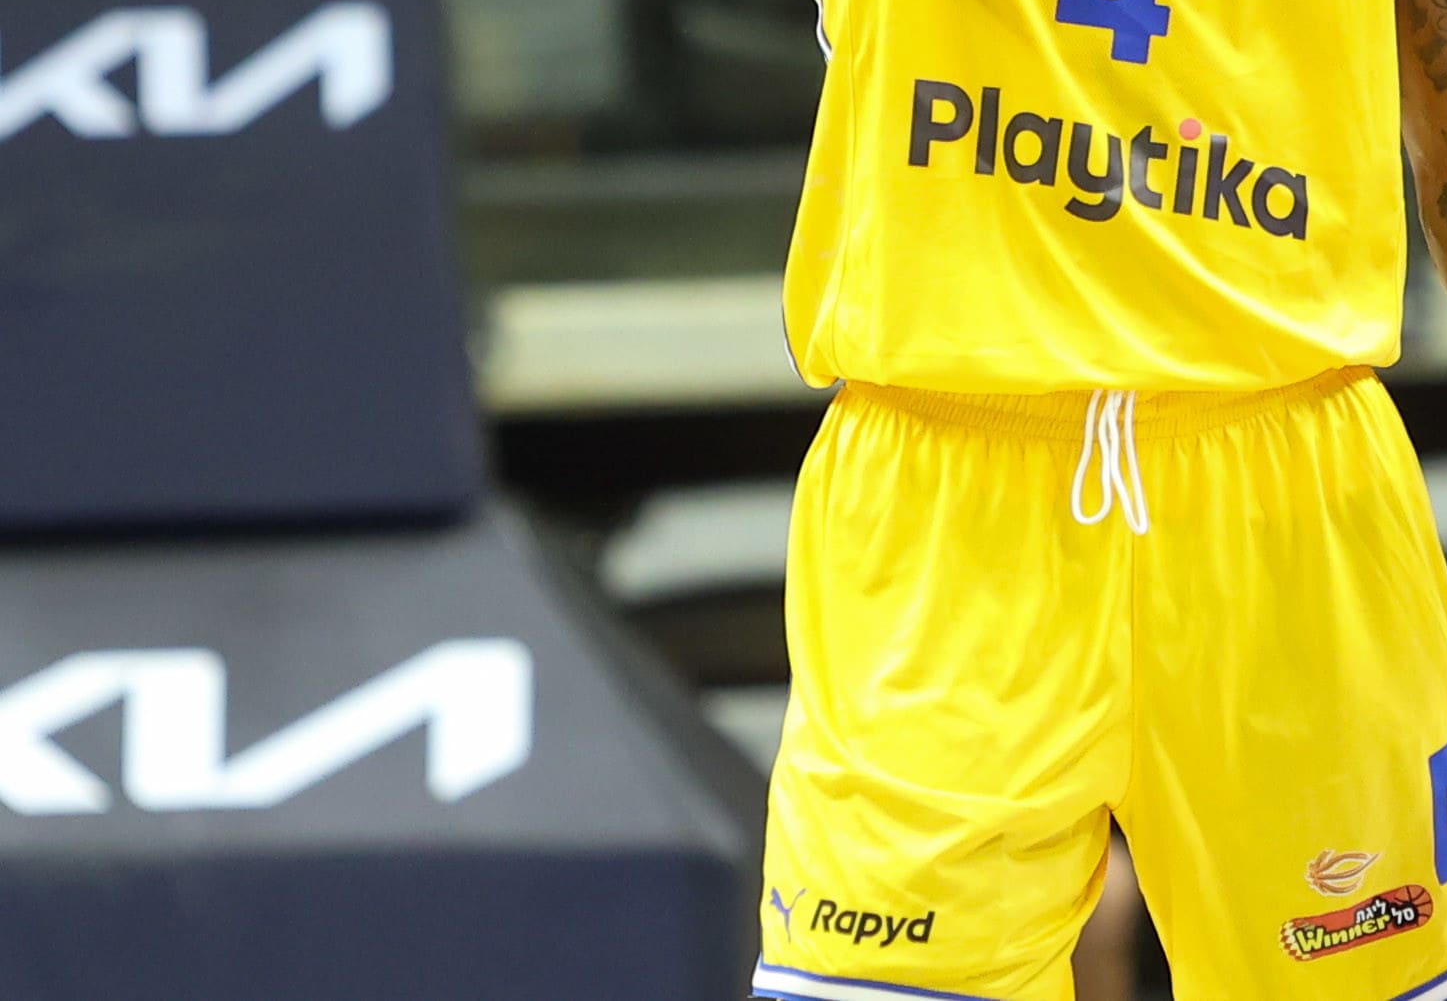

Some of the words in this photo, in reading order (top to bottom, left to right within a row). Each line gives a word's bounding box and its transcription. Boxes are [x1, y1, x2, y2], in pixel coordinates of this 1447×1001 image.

[908, 78, 1309, 241] Playtika
[810, 898, 936, 948] Rapyd
[1295, 914, 1391, 952] Winner
[1391, 907, 1415, 926] סל
